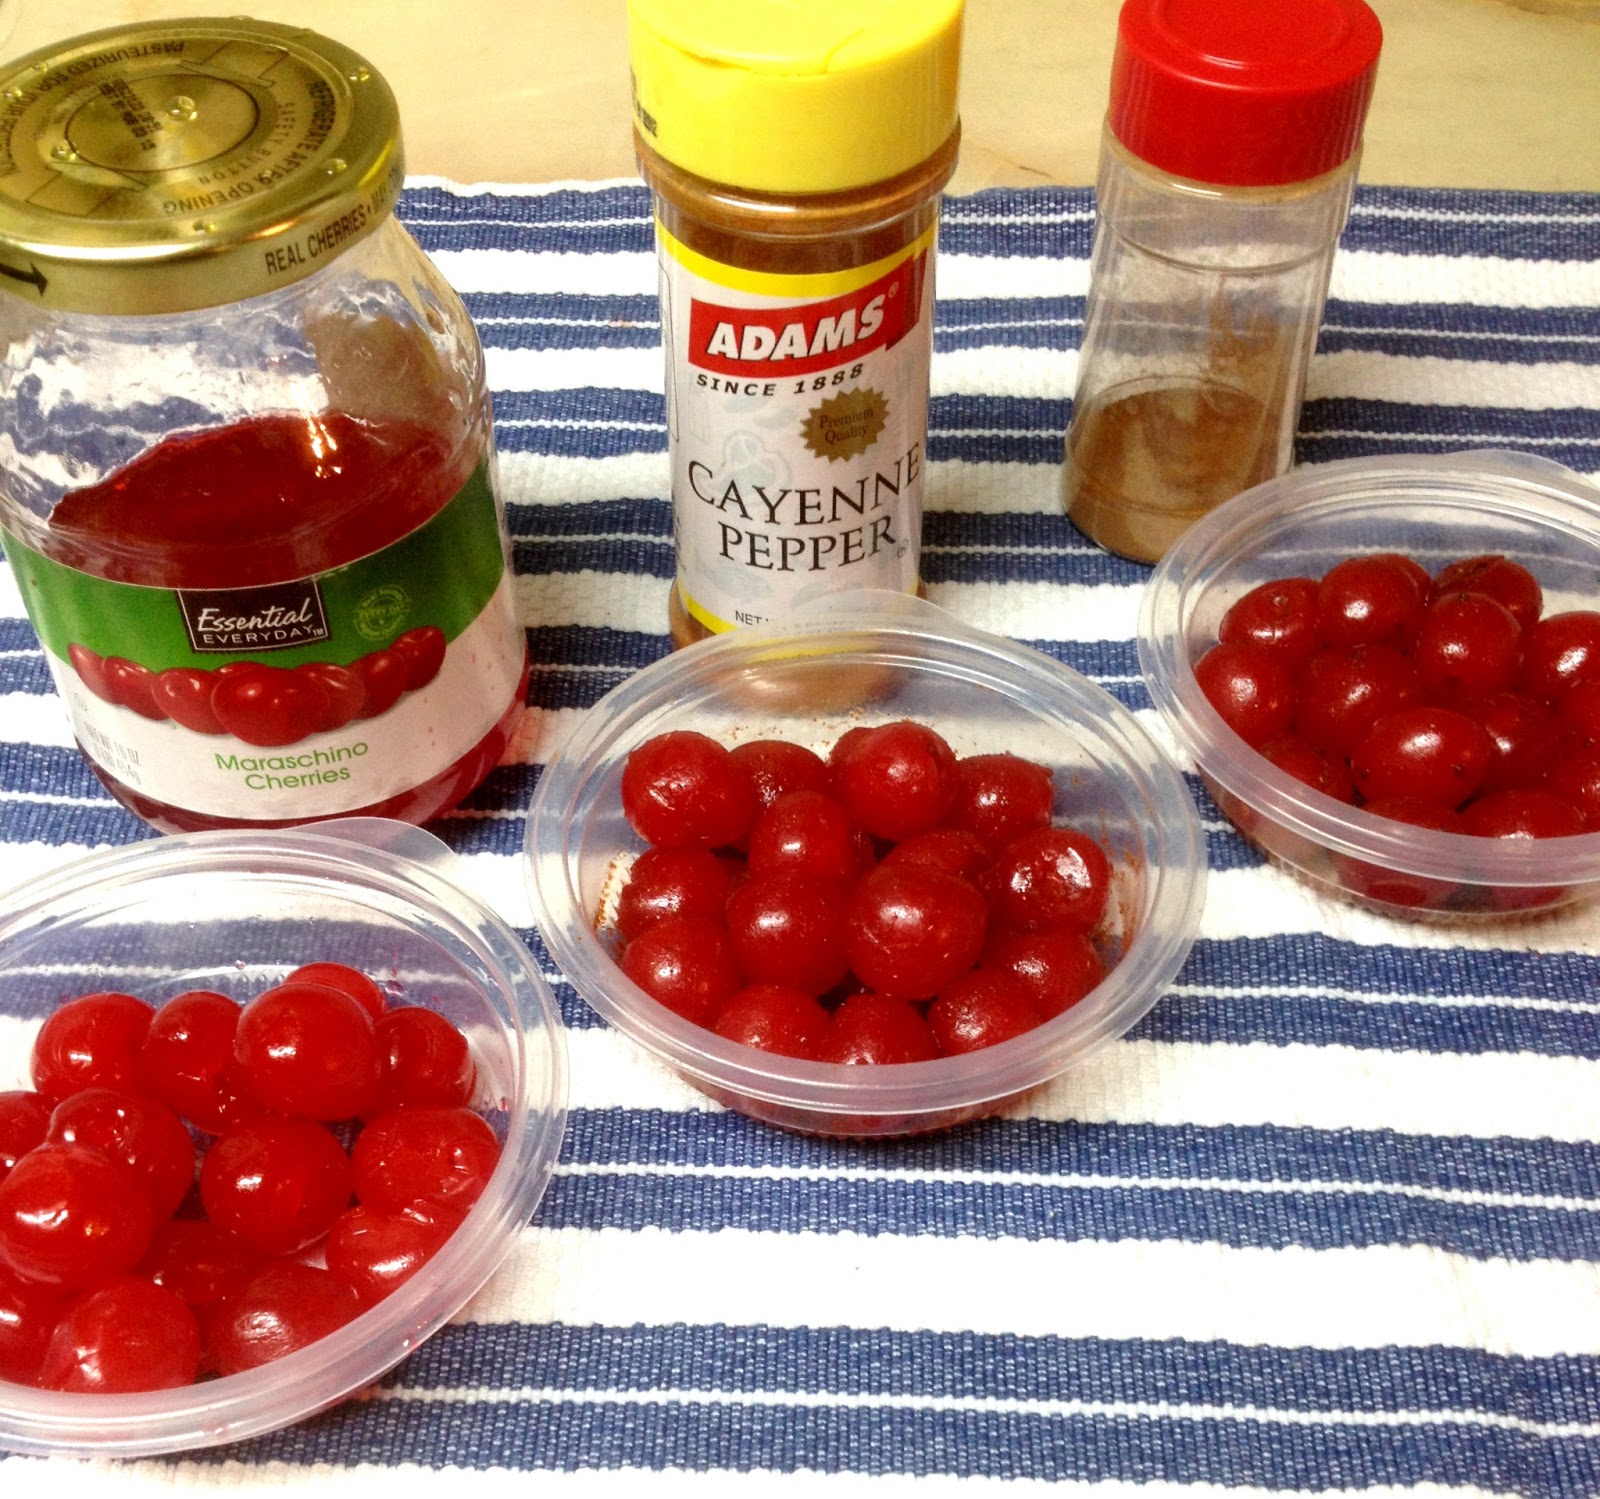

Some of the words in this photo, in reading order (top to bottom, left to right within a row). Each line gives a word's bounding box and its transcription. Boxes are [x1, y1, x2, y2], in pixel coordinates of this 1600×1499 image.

[68, 40, 185, 76] PASTEURIZED
[255, 151, 308, 185] AFTER
[163, 181, 254, 214] OPENING
[264, 242, 306, 275] REAL
[306, 203, 368, 258] CHERRIES
[706, 293, 887, 362] ADAMS
[696, 373, 777, 397] SINCE
[793, 362, 865, 395] 1888
[819, 408, 874, 430] Premium
[824, 424, 870, 445] Quality
[688, 441, 920, 527] CAYENNE
[717, 514, 897, 572] PEPPER
[197, 597, 313, 632] Essential
[734, 610, 762, 626] NET
[202, 624, 313, 644] EVERYDAY
[214, 742, 369, 772] Maraschino
[244, 767, 351, 790] Cherries
